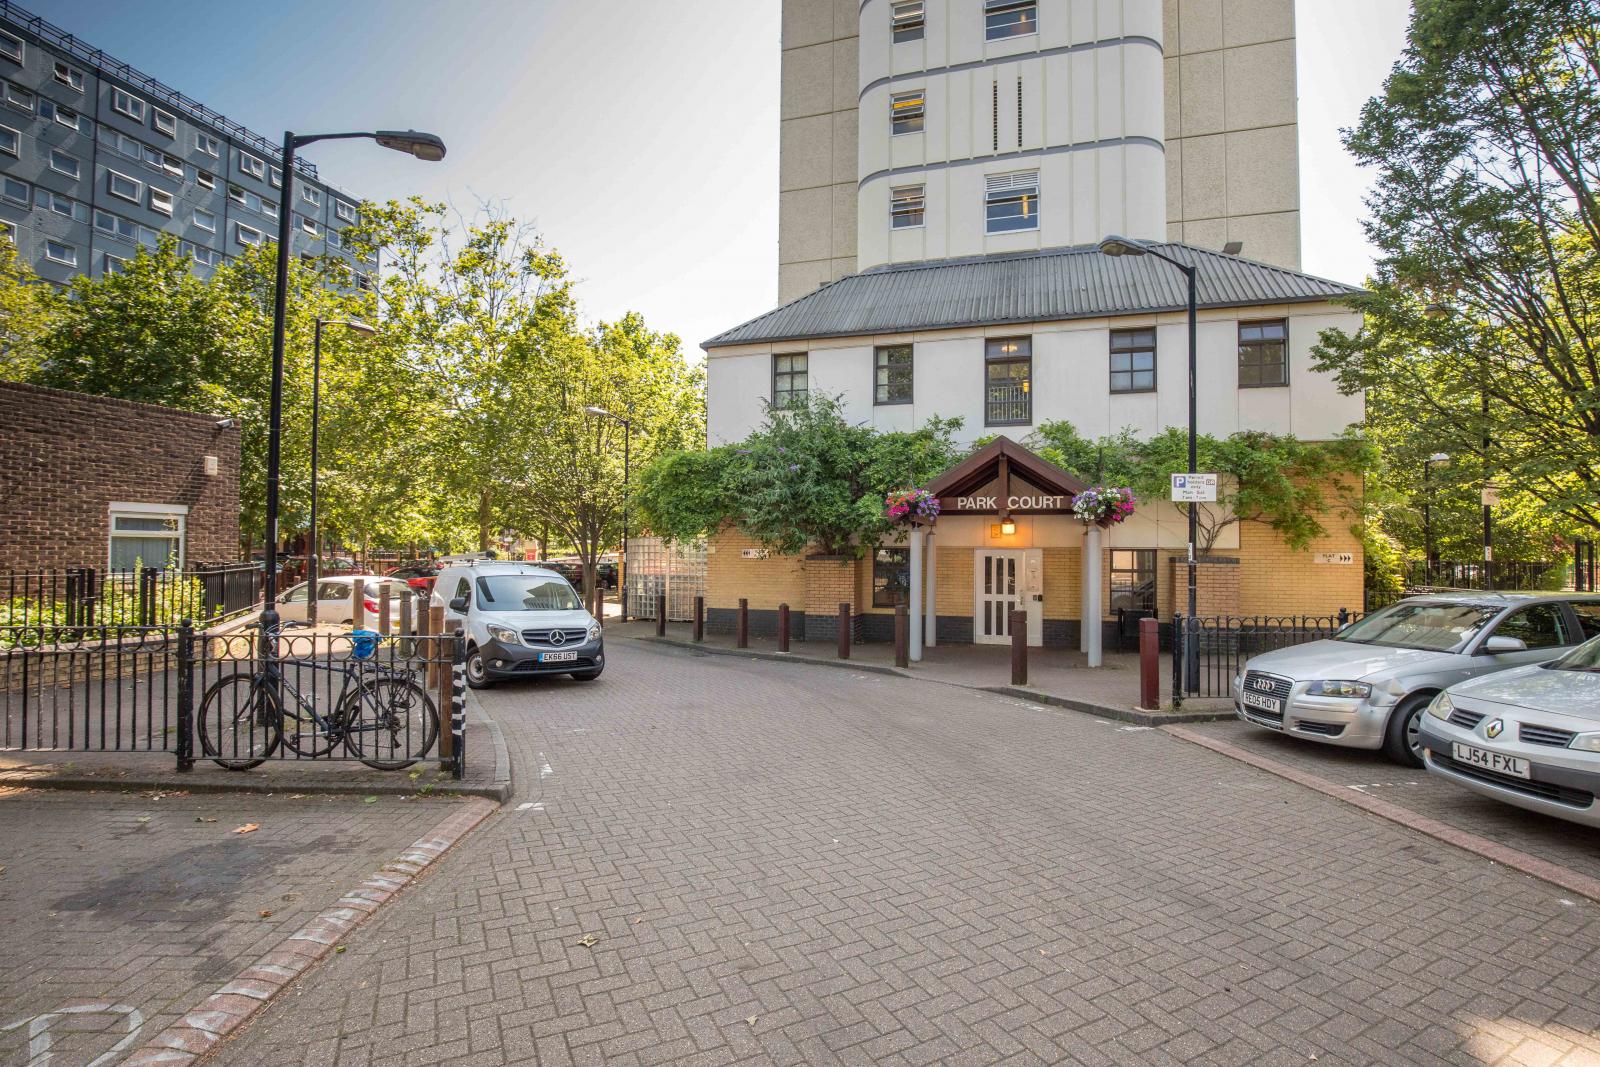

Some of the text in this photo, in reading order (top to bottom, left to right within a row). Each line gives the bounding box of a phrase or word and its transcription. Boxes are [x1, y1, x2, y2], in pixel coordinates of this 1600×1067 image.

[957, 495, 1064, 509] PARK COURT
[563, 652, 575, 660] UST
[1261, 697, 1277, 710] HDY
[1457, 744, 1523, 774] LJ54 FXL
